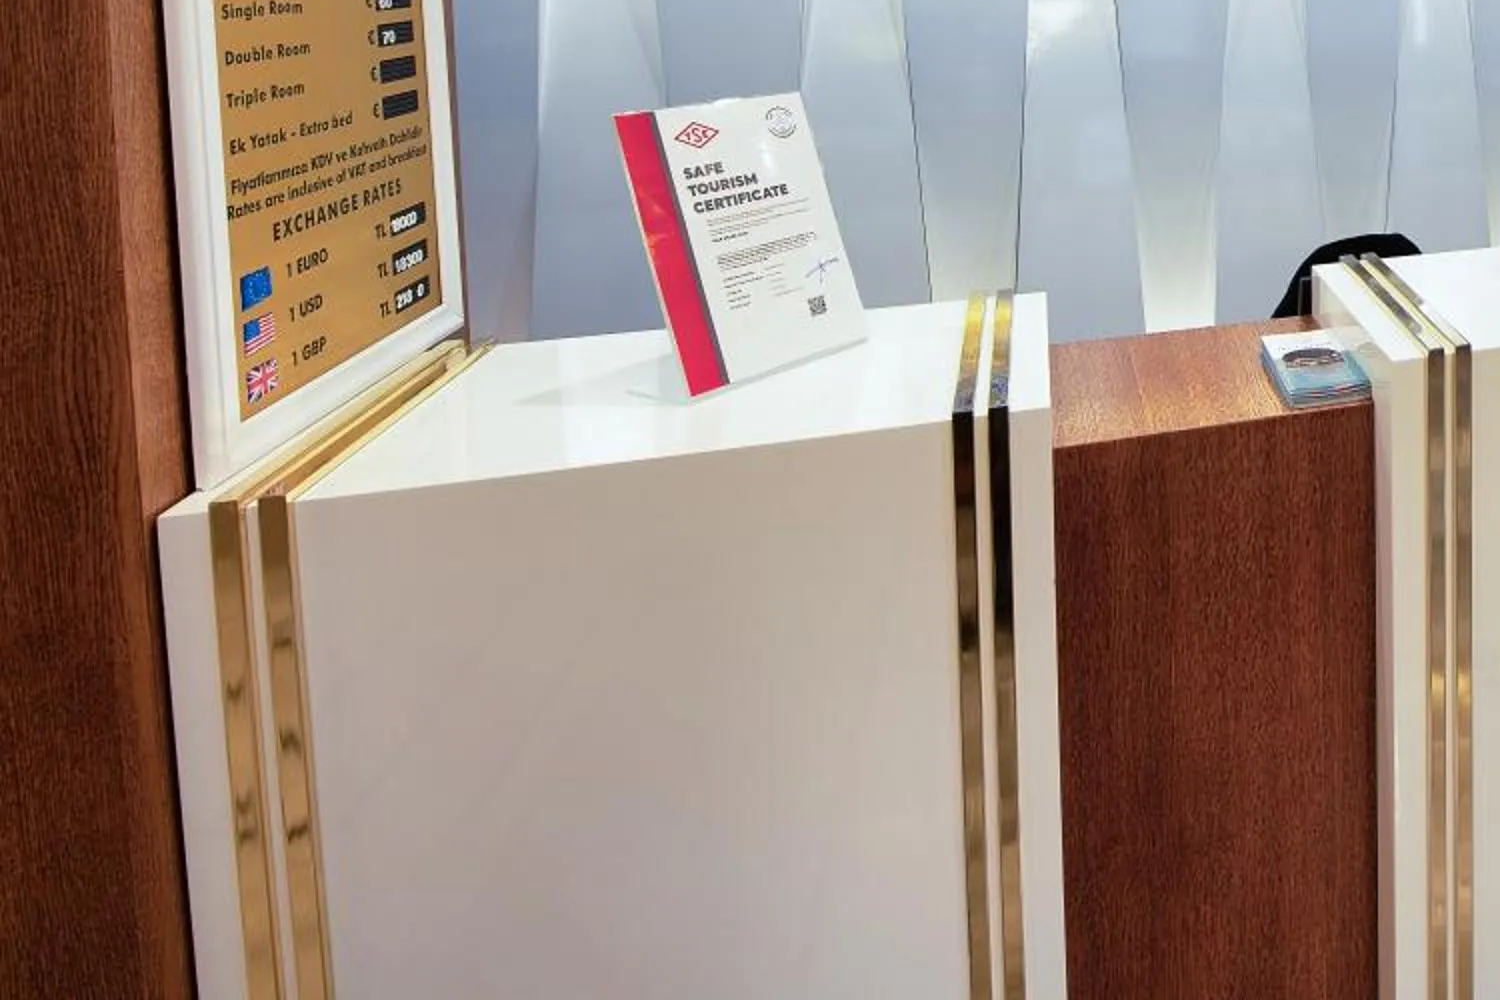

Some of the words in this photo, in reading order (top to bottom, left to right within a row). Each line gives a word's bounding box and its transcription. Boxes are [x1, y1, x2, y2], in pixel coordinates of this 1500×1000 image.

[221, 1, 265, 20] Single
[269, 0, 302, 15] Room
[225, 47, 273, 66] Double
[278, 43, 311, 57] Room
[226, 86, 267, 109] Triple
[271, 83, 305, 100] Room
[229, 137, 246, 155] Ek
[250, 128, 287, 149] Yatak
[300, 121, 329, 137] Extra
[332, 111, 353, 129] bed
[683, 162, 725, 180] SAFE
[687, 172, 759, 197] TOURISM
[227, 200, 261, 221] Rates
[265, 193, 285, 207] are
[273, 193, 359, 242] EXCHANGE
[363, 178, 401, 207] RATES
[693, 183, 789, 214] CERTIFICATE
[296, 247, 329, 275] EURO
[375, 224, 387, 240] TL
[299, 294, 323, 318] USD
[377, 262, 390, 279] TL
[301, 335, 328, 361] GBP
[379, 302, 392, 319] TL
